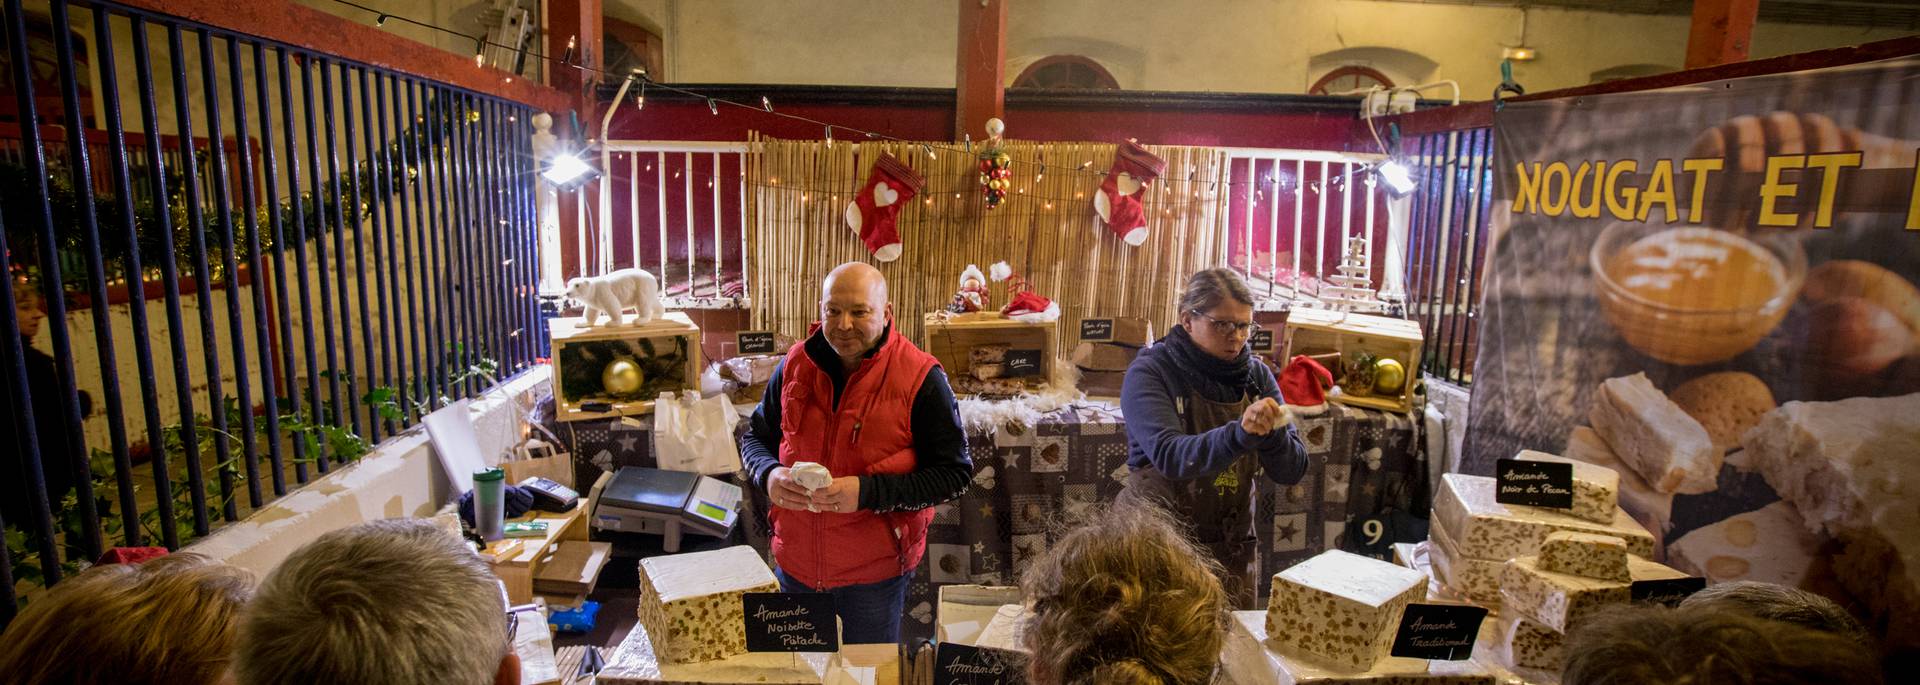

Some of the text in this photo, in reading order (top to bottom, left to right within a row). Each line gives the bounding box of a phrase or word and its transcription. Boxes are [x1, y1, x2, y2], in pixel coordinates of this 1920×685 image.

[1511, 158, 1725, 225] NOUGAT
[1757, 151, 1864, 229] ET
[1362, 519, 1384, 546] 9
[753, 603, 809, 622] Amande
[767, 620, 816, 634] Noisette
[1409, 615, 1457, 633] Amande
[945, 655, 1004, 675] Amande
